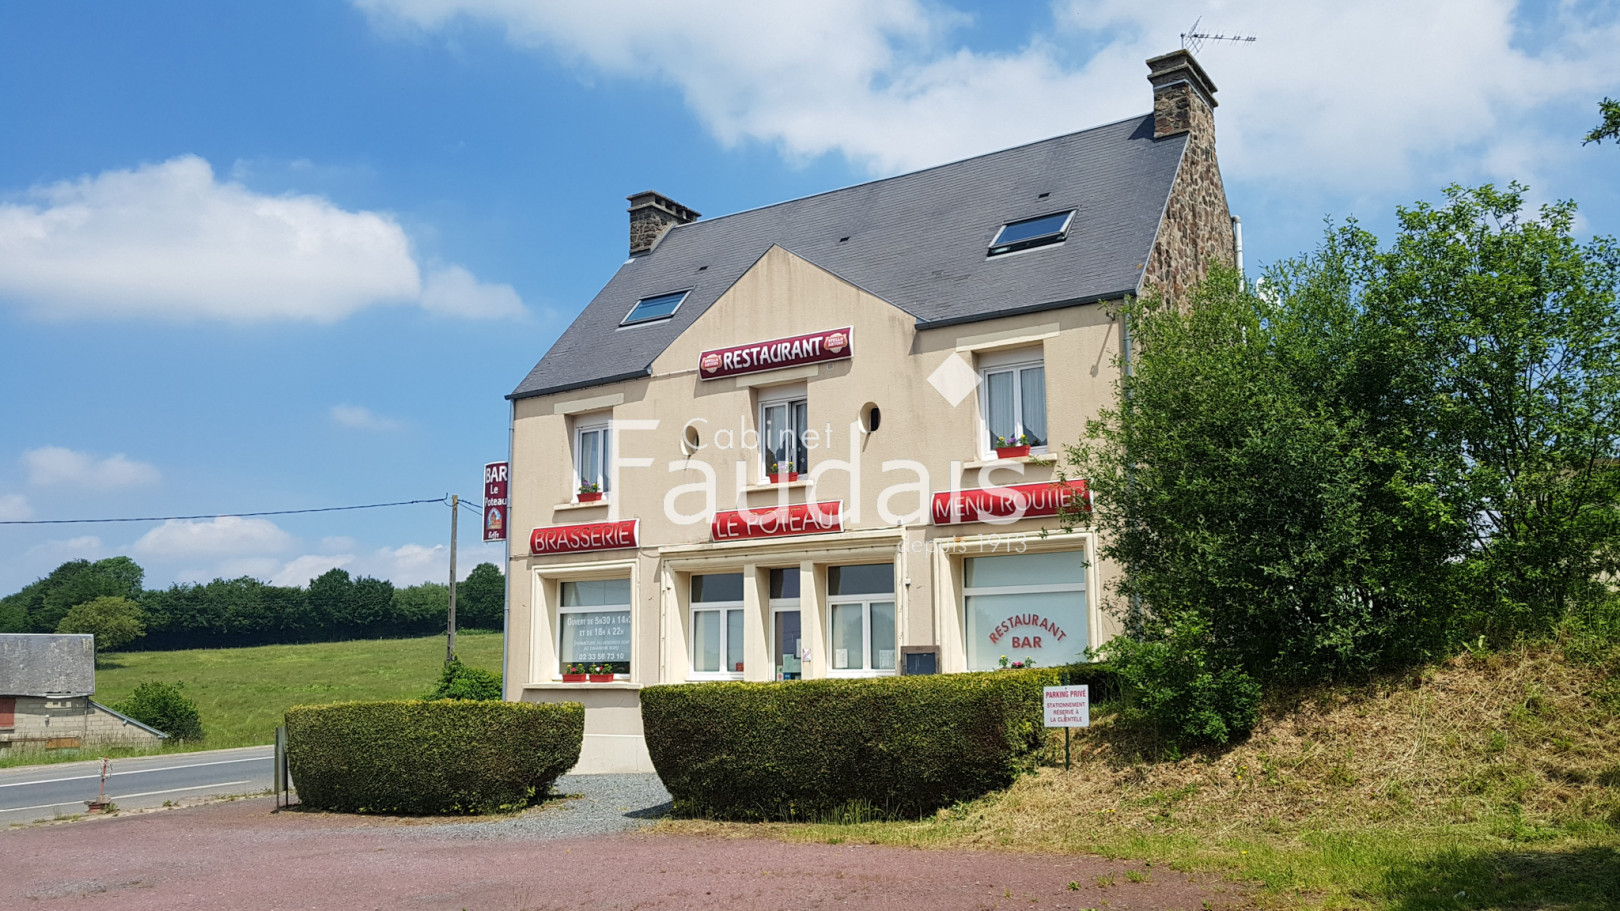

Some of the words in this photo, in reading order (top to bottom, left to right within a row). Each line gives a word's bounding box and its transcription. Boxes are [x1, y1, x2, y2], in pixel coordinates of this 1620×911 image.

[723, 337, 823, 371] RESTAURANT
[485, 466, 508, 484] BAR
[490, 484, 499, 495] Le
[485, 497, 507, 508] Poteau
[936, 492, 994, 518] MENU
[1000, 486, 1086, 513] ROUTIER
[716, 512, 739, 538] LE
[747, 504, 834, 535] POTEAU
[534, 523, 632, 552] BRASSERIE
[989, 613, 1067, 645] RESTAURANT
[1012, 636, 1043, 649] BAR
[1045, 690, 1070, 699] PARKING
[1070, 689, 1087, 698] PRIVÉ
